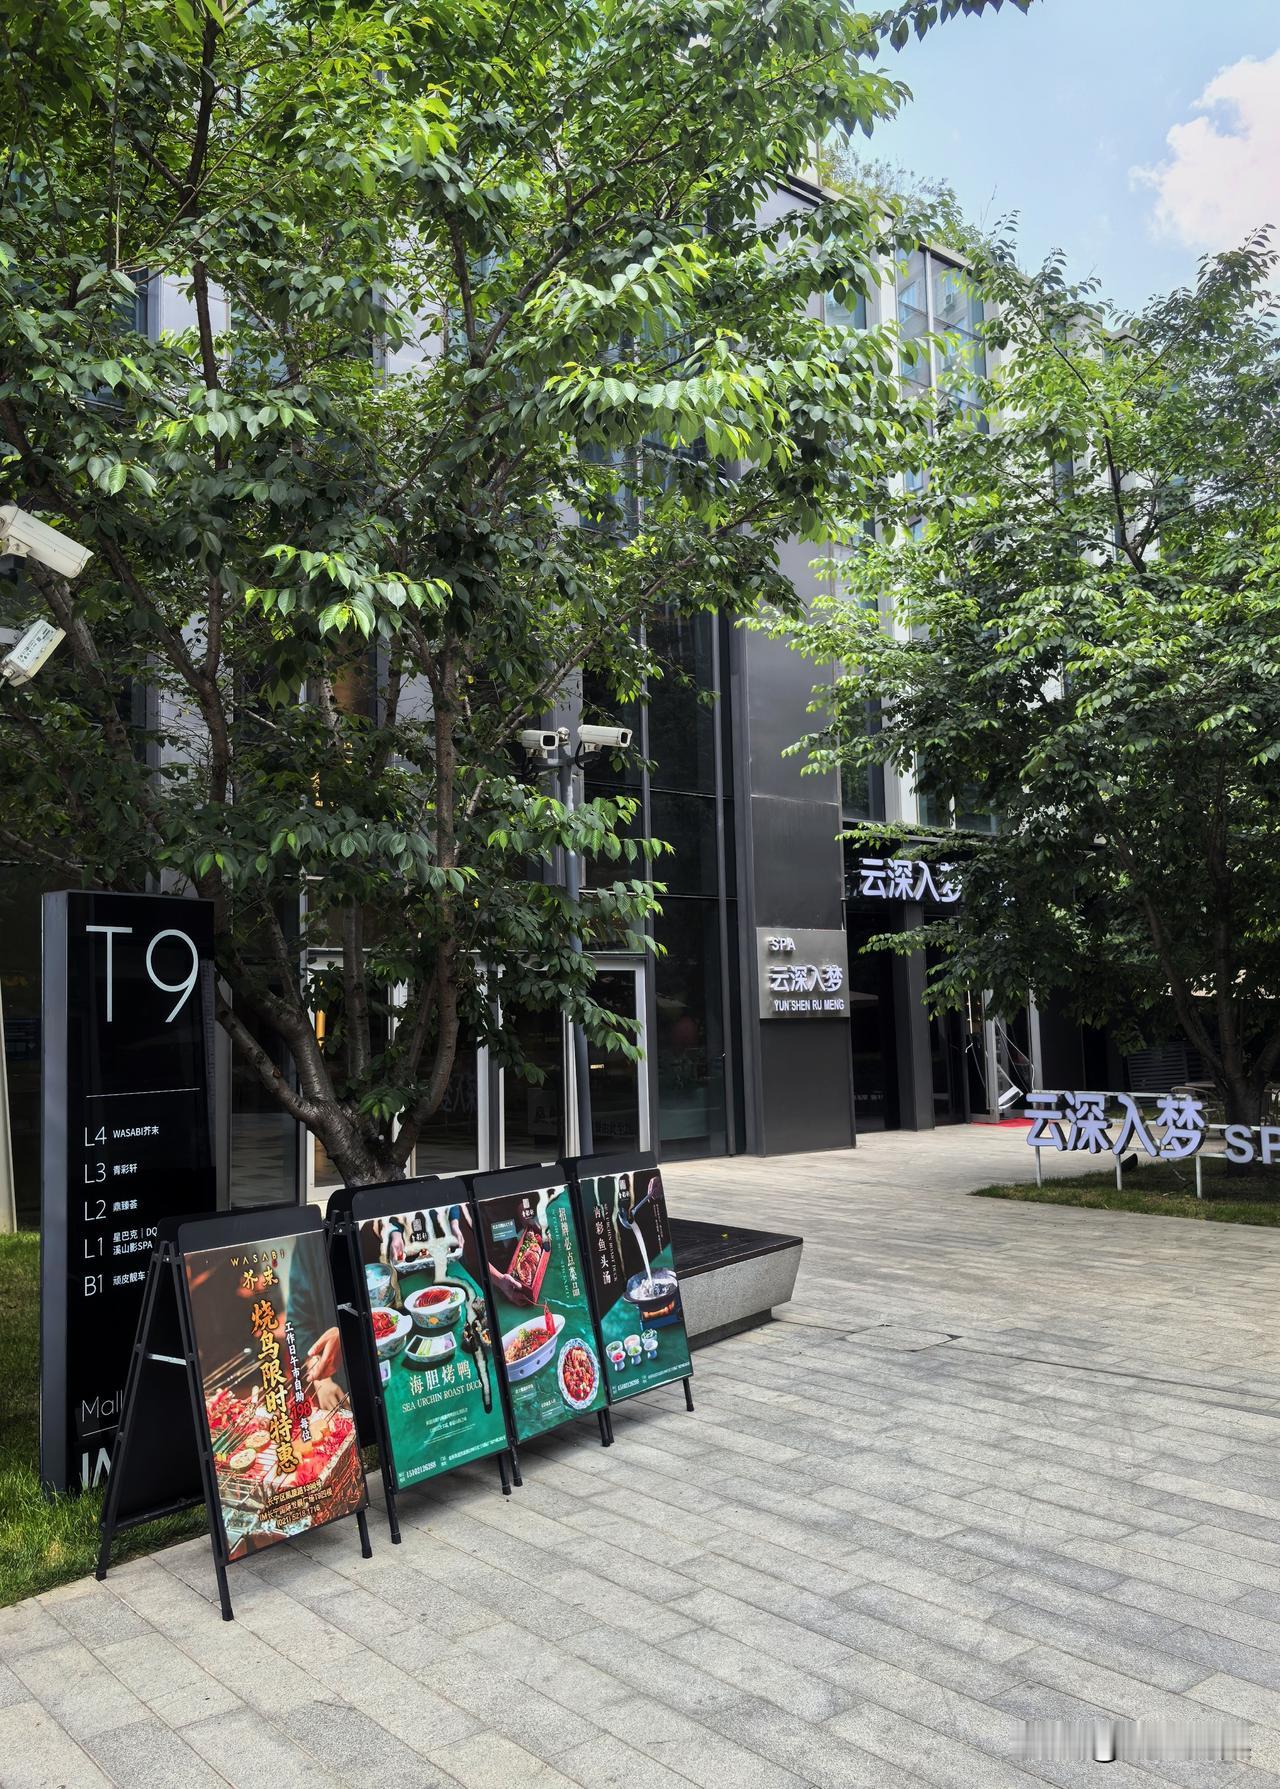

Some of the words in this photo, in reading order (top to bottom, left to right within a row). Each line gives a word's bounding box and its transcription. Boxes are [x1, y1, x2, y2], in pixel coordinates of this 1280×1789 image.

[768, 936, 796, 951] SPA
[85, 925, 199, 1023] T9
[768, 964, 844, 992] 云深入梦
[774, 1000, 790, 1011] YUN
[791, 1000, 811, 1011] SHEN
[812, 1000, 823, 1010] RU
[824, 999, 845, 1010] MENG
[1024, 1091, 1205, 1159] 云深入梦
[84, 1126, 107, 1147] L4
[84, 1162, 107, 1184] L3
[84, 1199, 107, 1221] L2
[112, 1229, 139, 1243] 星巴克
[146, 1226, 158, 1237] DQ
[84, 1237, 103, 1259] L1
[230, 1249, 286, 1267] WASABI
[84, 1274, 103, 1297] B1
[242, 1265, 279, 1290] 芥末
[251, 1299, 299, 1476] 烧鸟限时特惠
[409, 1359, 472, 1396] 海胆烤鸭
[402, 1400, 417, 1413] SEA
[417, 1391, 443, 1408] URCHIN
[443, 1384, 466, 1400] ROAST
